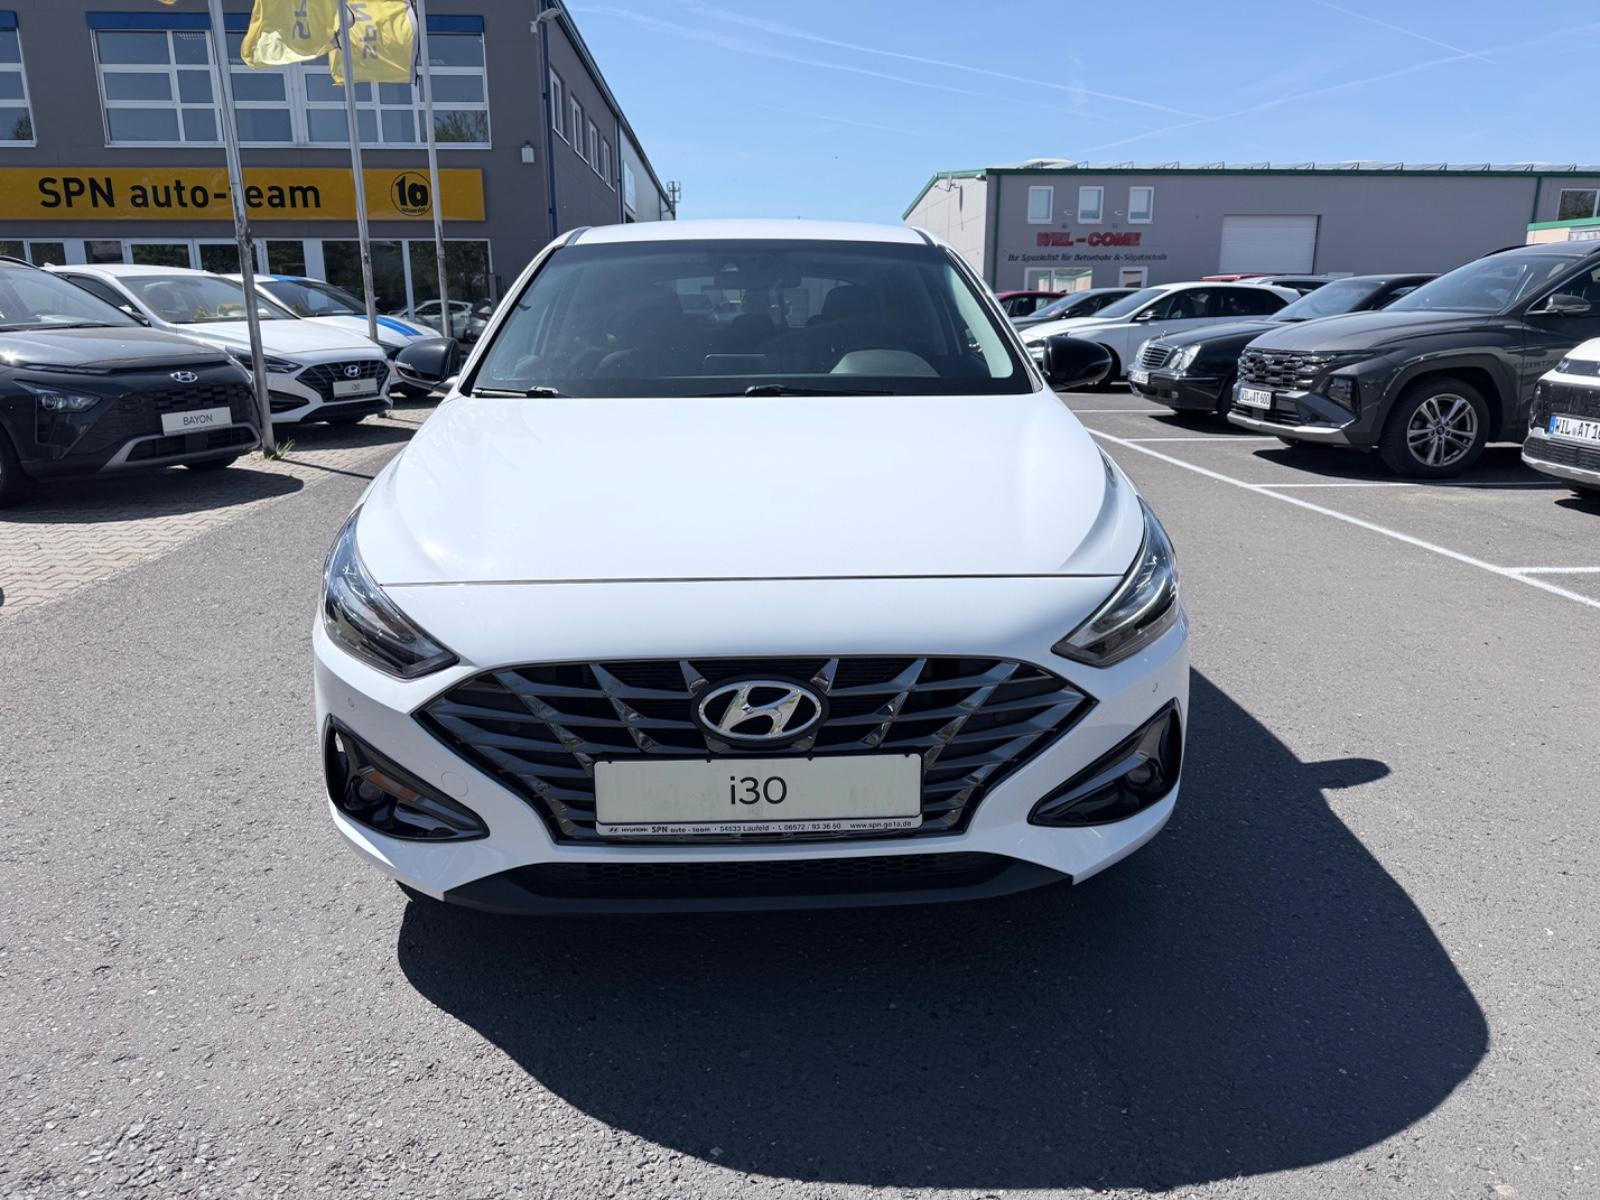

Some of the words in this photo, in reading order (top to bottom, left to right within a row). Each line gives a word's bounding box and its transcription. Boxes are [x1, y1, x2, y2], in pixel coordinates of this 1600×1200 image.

[38, 177, 115, 208] SPN
[129, 179, 321, 209] auto-eam
[183, 414, 213, 425] BAYON
[1578, 422, 1591, 438] AT
[730, 776, 787, 805] i30
